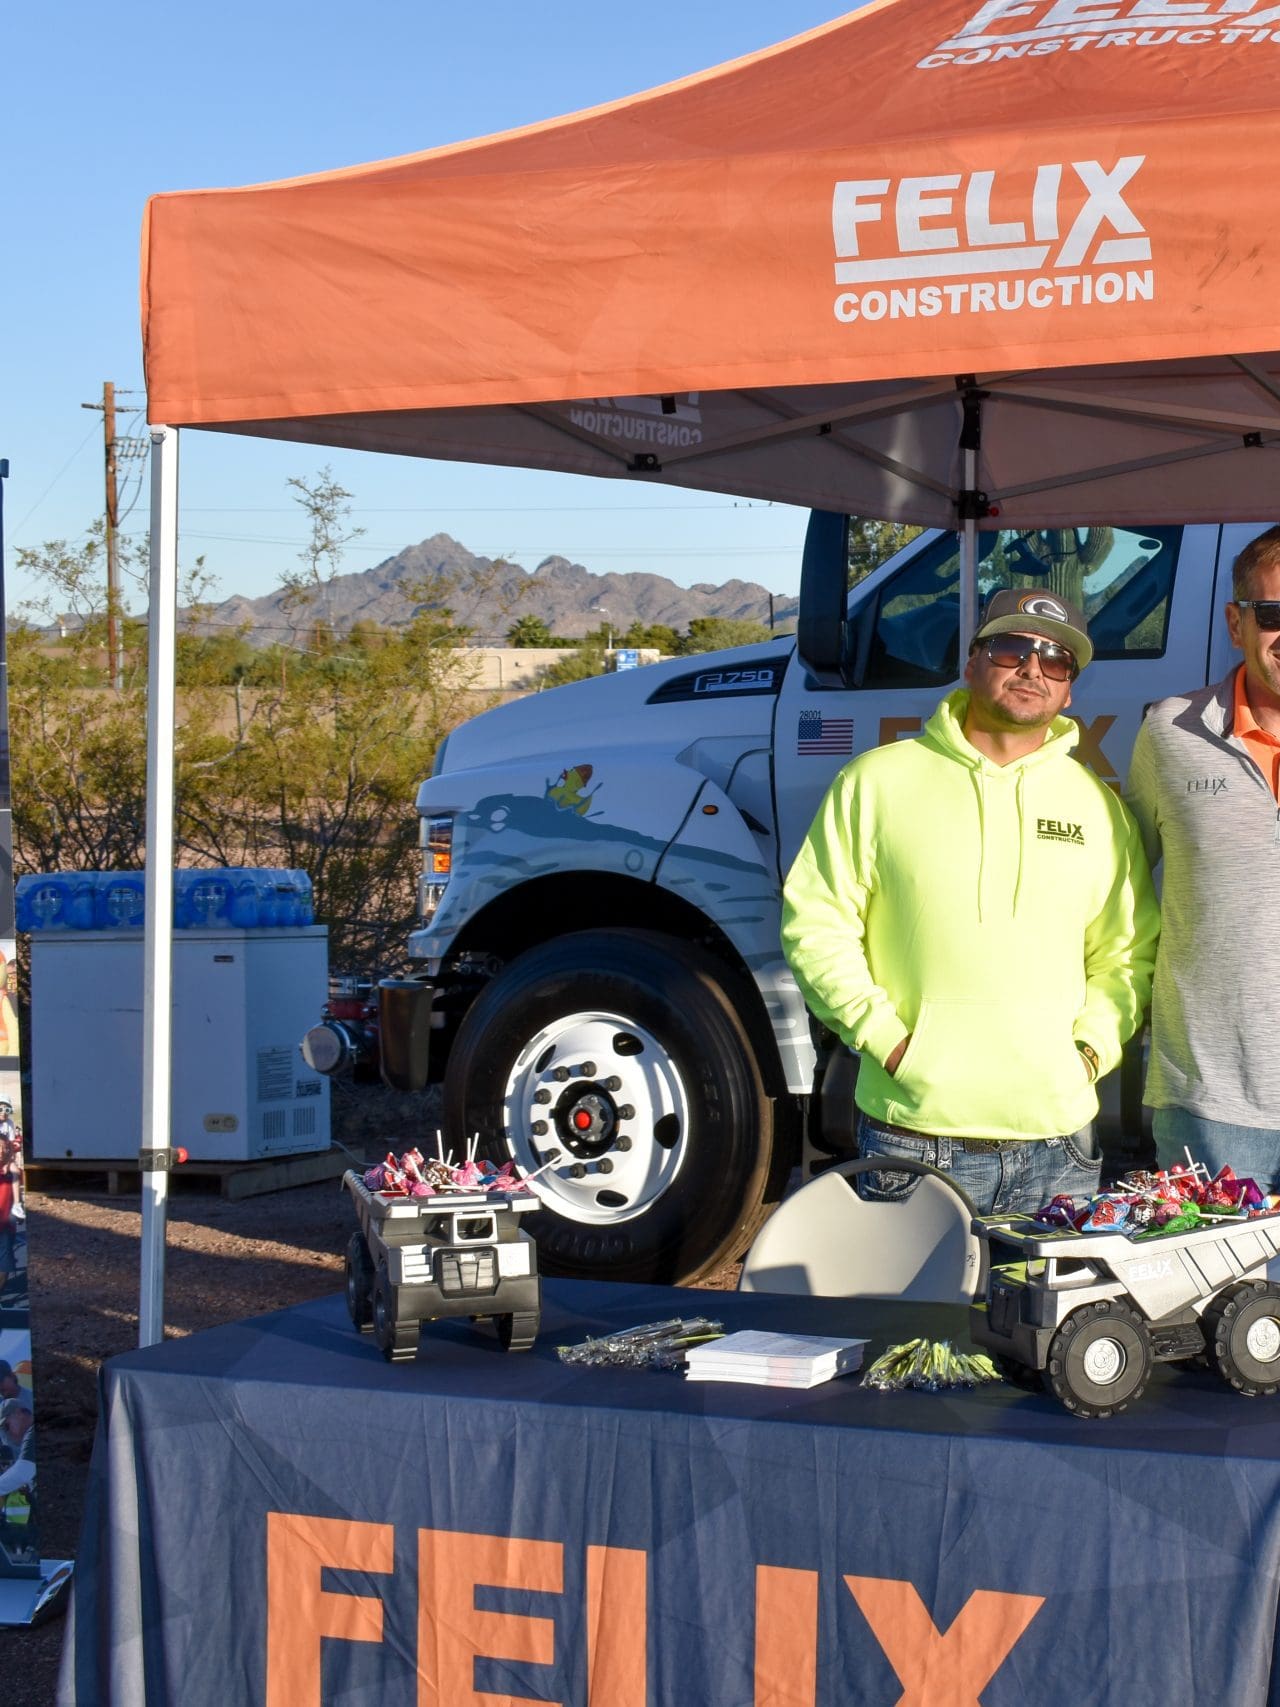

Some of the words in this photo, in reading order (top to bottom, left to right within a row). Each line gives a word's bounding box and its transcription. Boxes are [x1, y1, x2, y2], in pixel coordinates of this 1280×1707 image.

[832, 155, 1148, 268] FELIX
[833, 270, 1154, 323] CONSTRUCTION
[1187, 778, 1227, 795] FELIX
[1037, 818, 1083, 838] FELIX
[1037, 834, 1085, 846] CONSTRUCTION
[1130, 1259, 1173, 1280] FELIX
